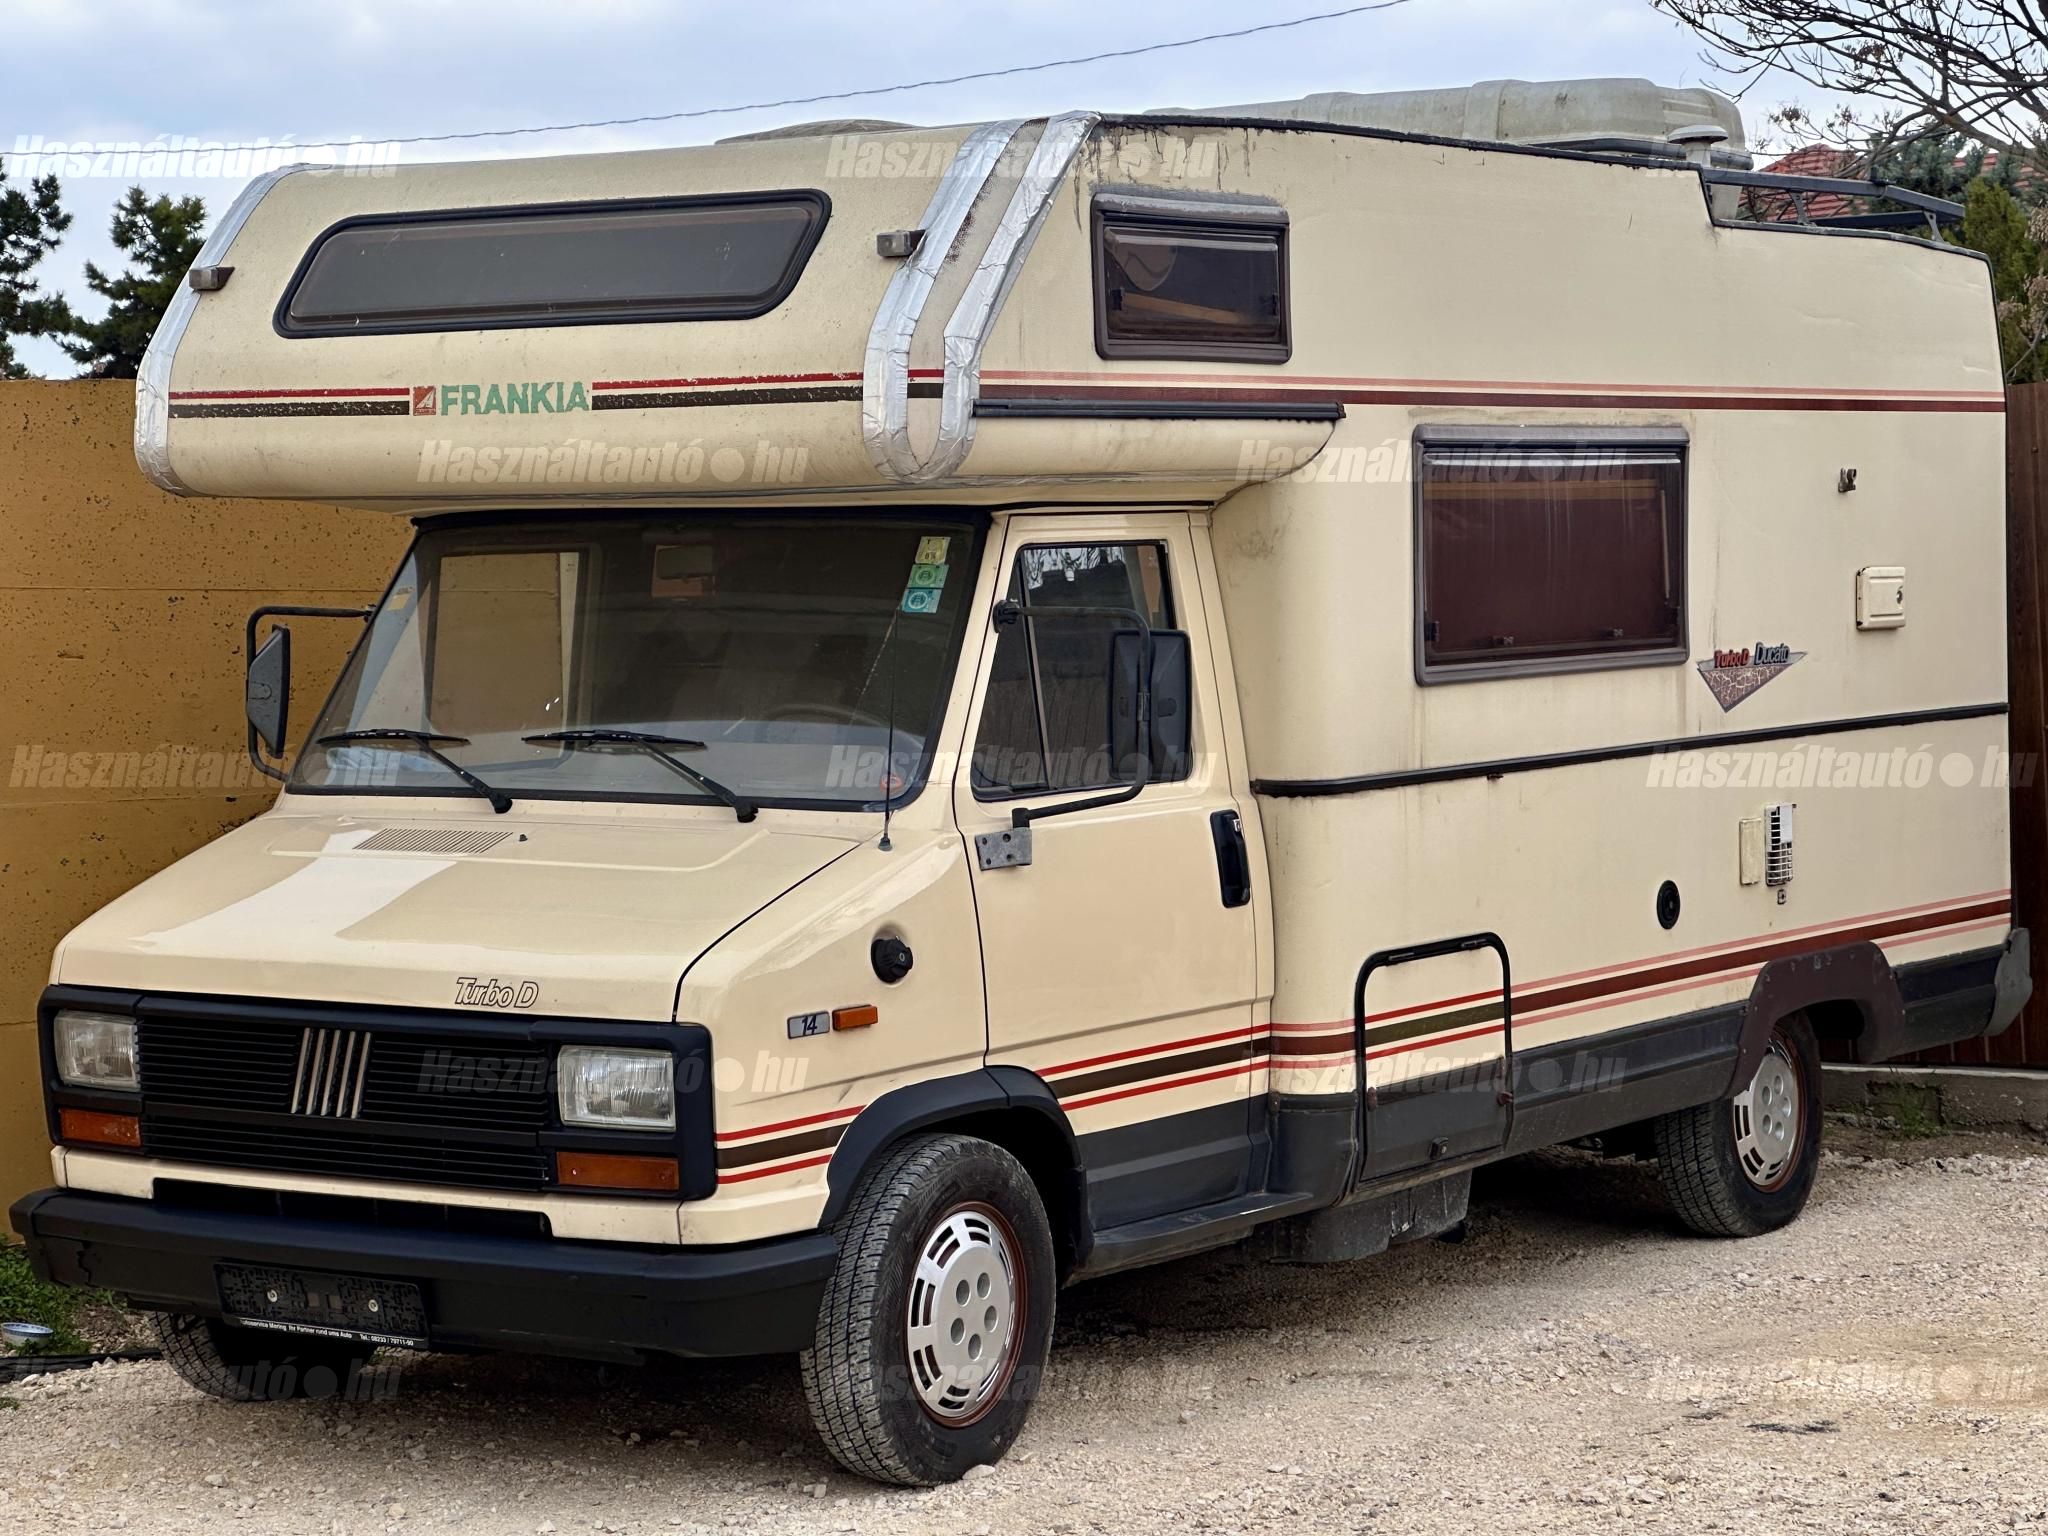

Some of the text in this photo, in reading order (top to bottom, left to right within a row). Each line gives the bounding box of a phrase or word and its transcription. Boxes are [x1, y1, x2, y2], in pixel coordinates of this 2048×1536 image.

[441, 382, 589, 416] FRANKIA
[1753, 641, 1791, 666] Ducato
[455, 977, 539, 1008] Turbo D
[801, 1015, 818, 1036] 14
[297, 1325, 315, 1335] Partner
[316, 1328, 328, 1336] rund
[340, 1330, 352, 1339] Auto
